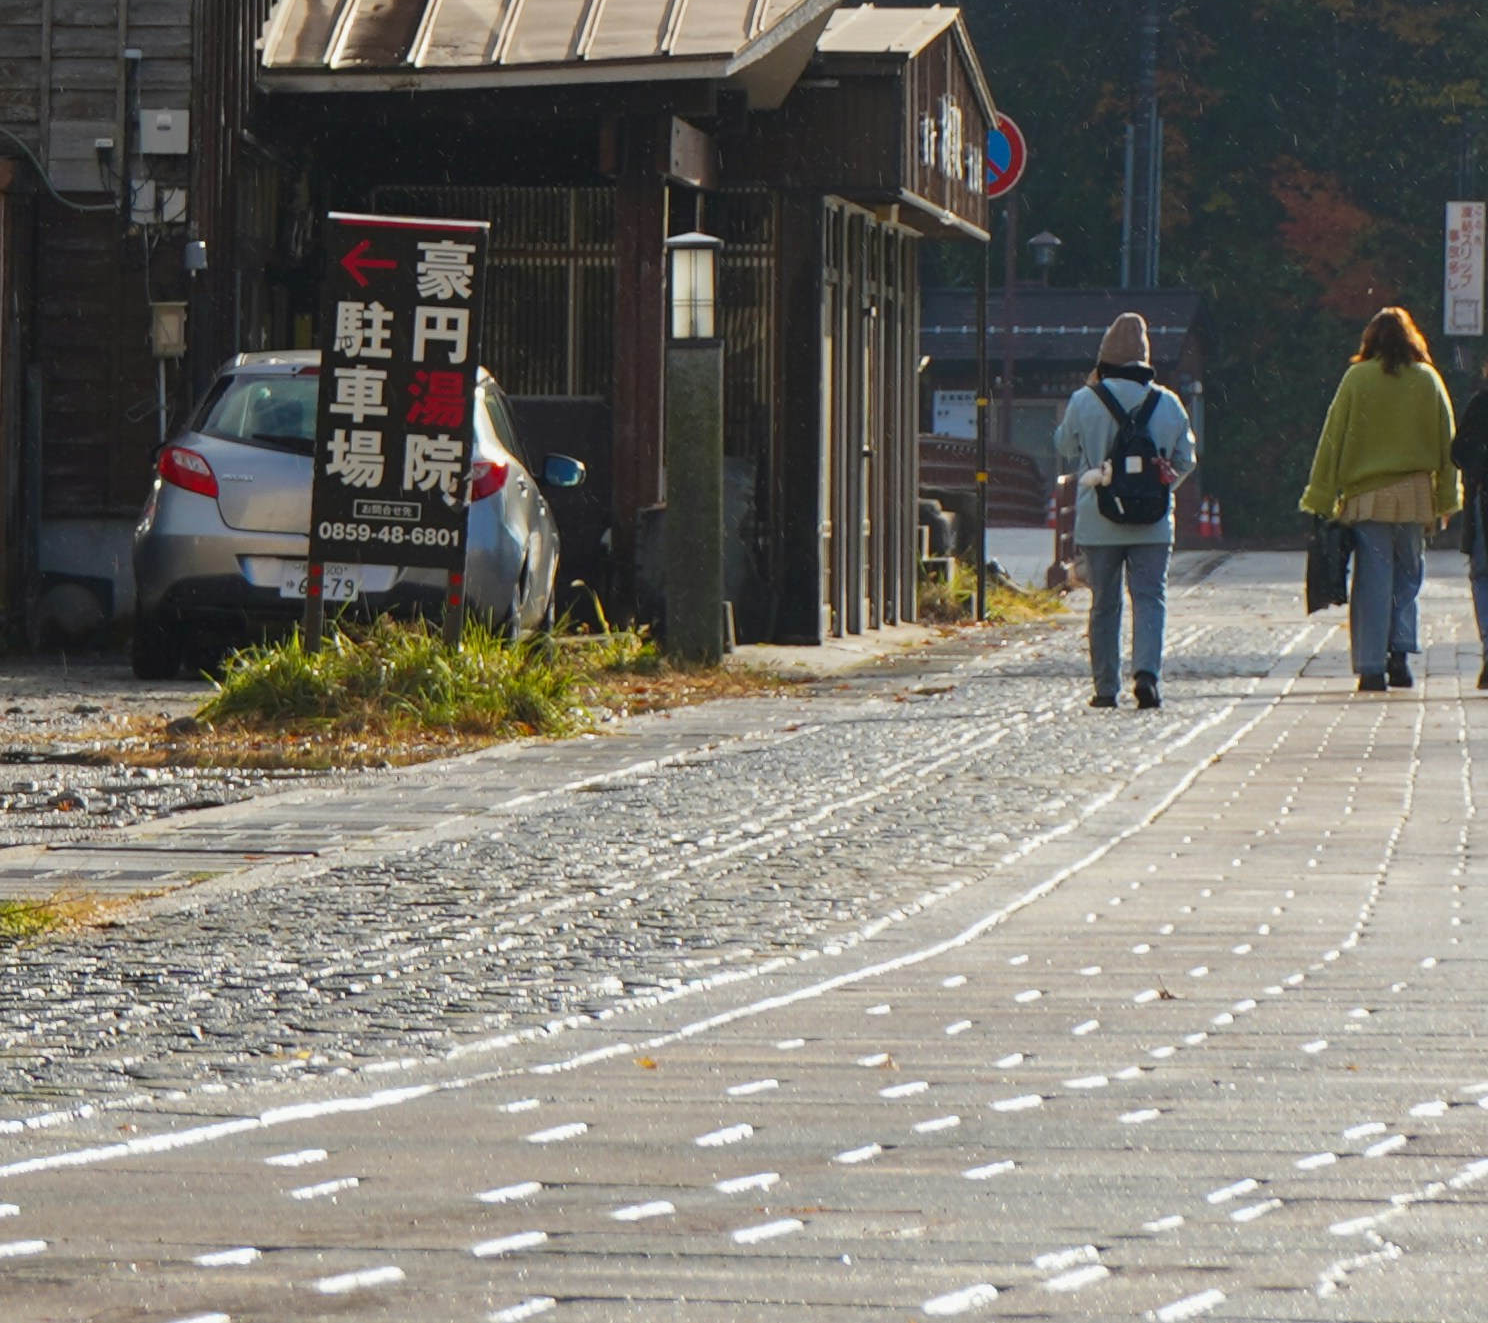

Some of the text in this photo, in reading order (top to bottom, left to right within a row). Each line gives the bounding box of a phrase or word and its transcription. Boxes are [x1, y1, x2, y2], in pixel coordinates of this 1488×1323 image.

[402, 239, 477, 500] 豪円湯院
[325, 300, 395, 490] 駐車場
[361, 503, 414, 518] お問合せ先
[318, 520, 460, 547] 0859-48-6801
[298, 576, 355, 598] 6-79
